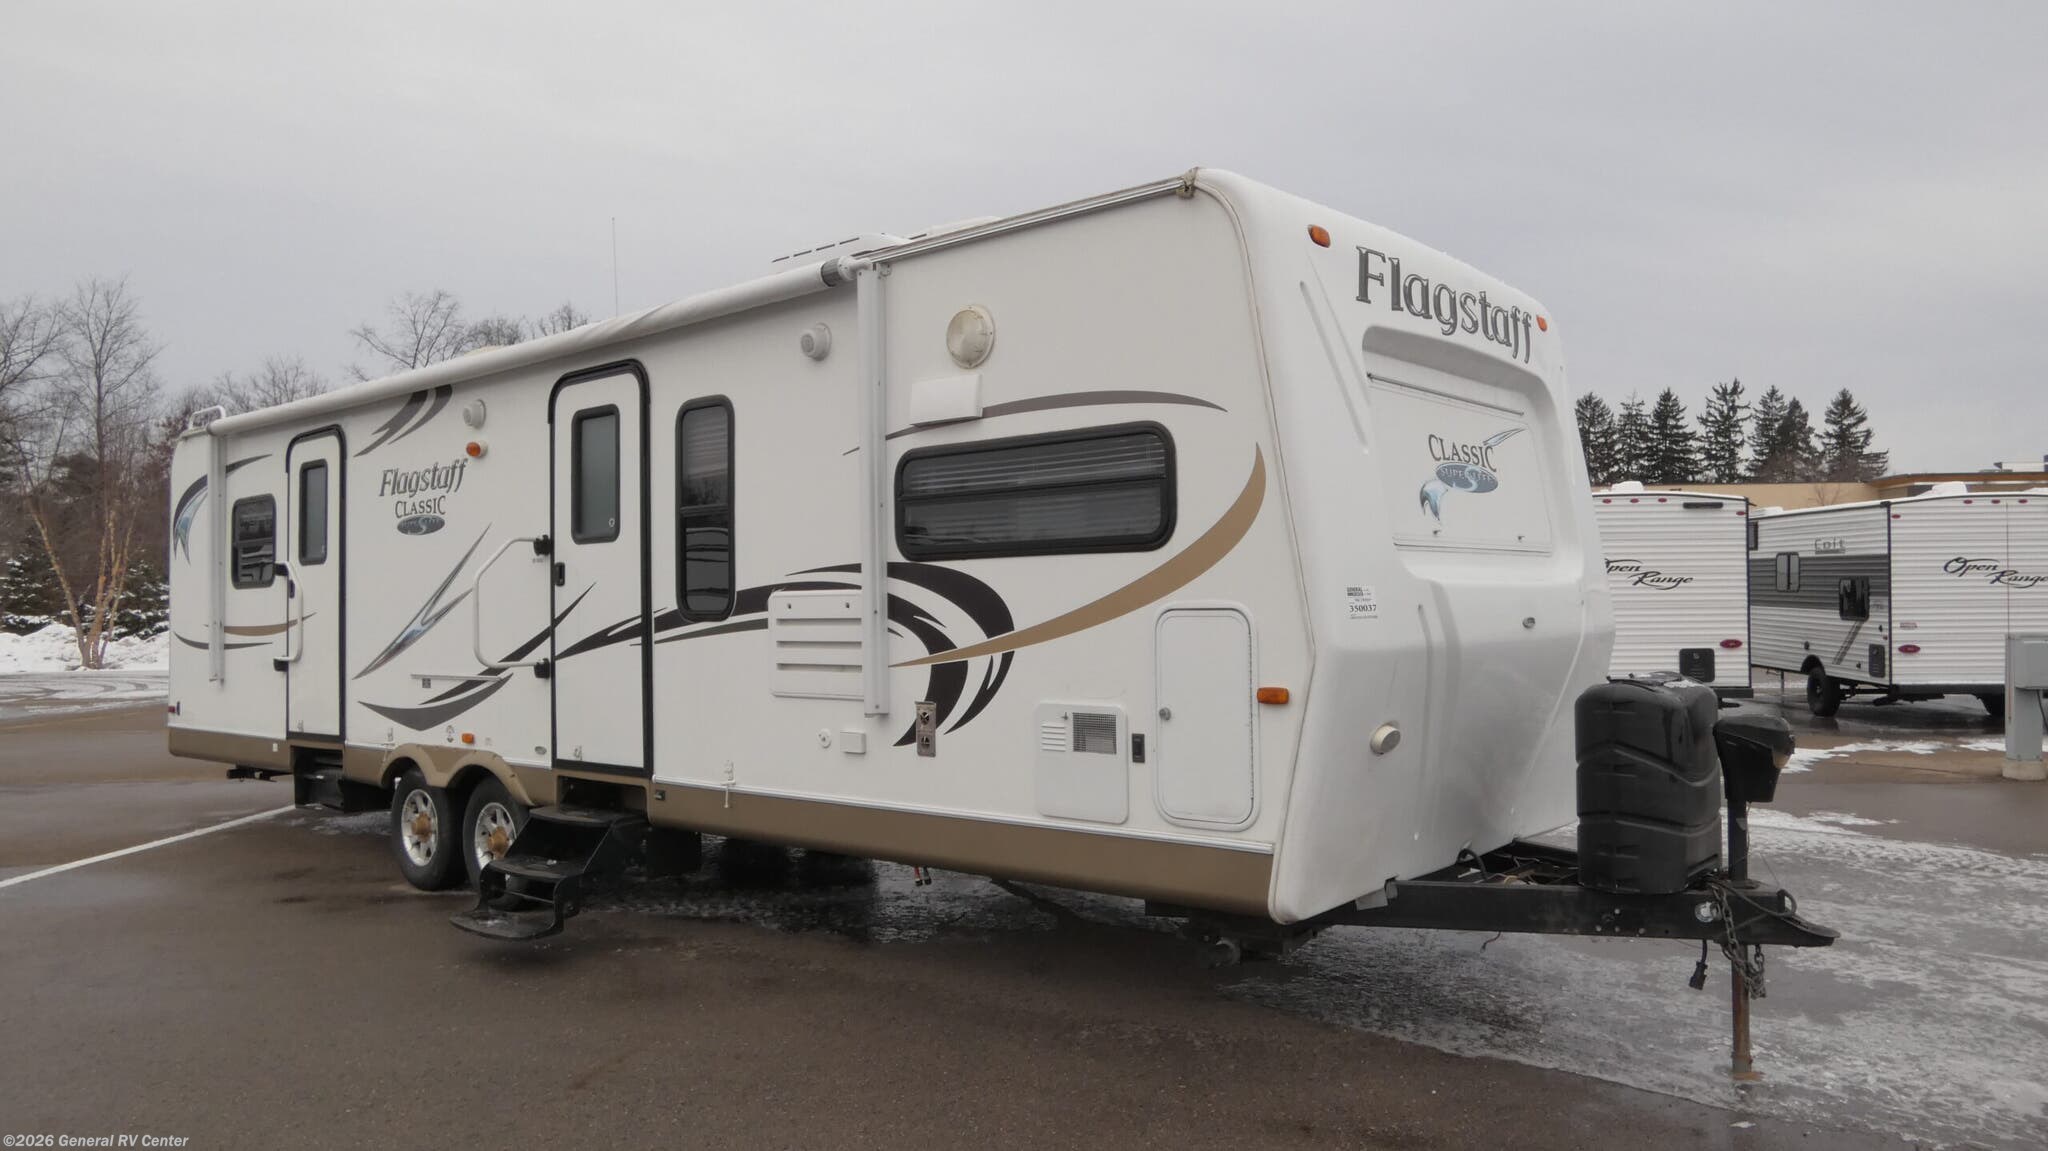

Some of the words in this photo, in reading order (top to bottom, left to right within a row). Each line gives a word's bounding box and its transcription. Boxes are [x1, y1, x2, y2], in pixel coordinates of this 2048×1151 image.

[1355, 245, 1533, 364] Flagstaff
[1428, 433, 1497, 473] CLASSIC
[379, 457, 469, 499] Flagstaff
[394, 495, 446, 519] CLASSIC
[1605, 558, 1644, 574] pen
[1943, 556, 2000, 578] Open
[1627, 570, 1694, 590] Range
[1984, 569, 2048, 589] Range
[1349, 604, 1377, 614] 350037
